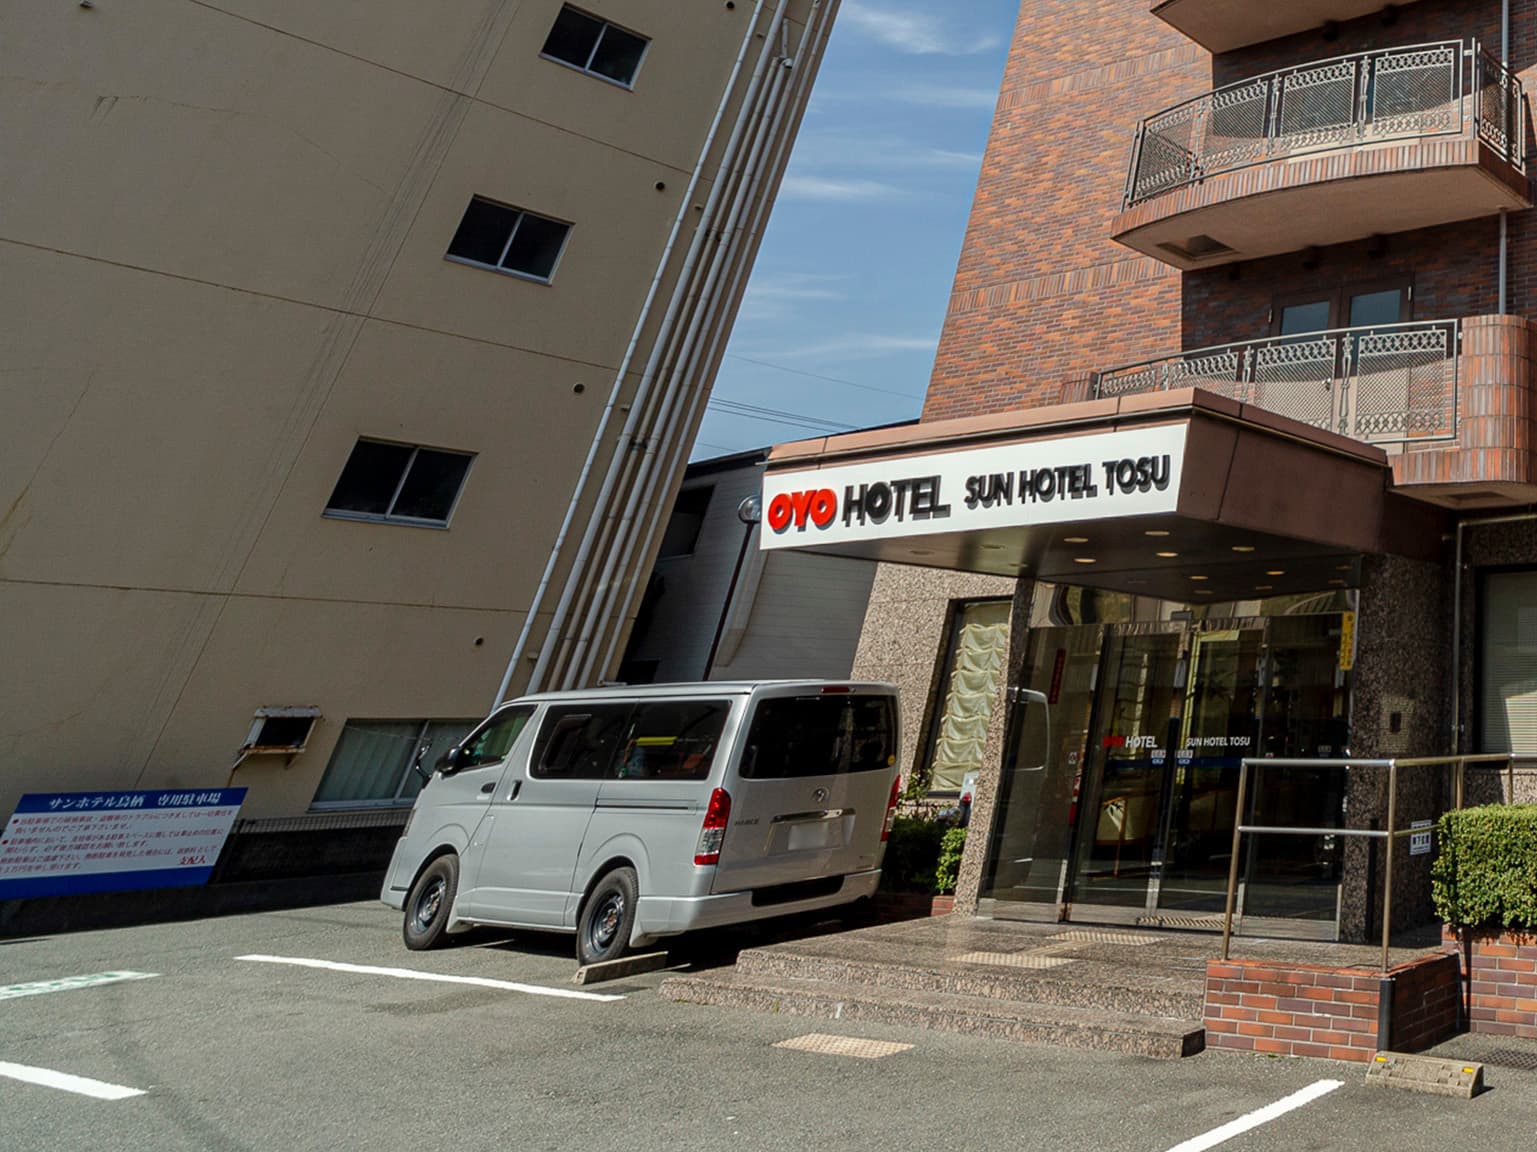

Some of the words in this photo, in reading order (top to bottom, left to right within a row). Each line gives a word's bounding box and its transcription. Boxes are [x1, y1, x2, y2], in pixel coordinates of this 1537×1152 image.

[768, 489, 837, 534] OYO
[842, 475, 951, 528] HOTEL
[964, 471, 1013, 509] SUN
[1019, 463, 1097, 503] HOTEL
[1102, 454, 1170, 494] TOSU
[1125, 736, 1158, 748] HOTEL
[1186, 737, 1202, 747] SUN
[1203, 737, 1228, 746] HOTEL
[1229, 736, 1251, 746] TOSU
